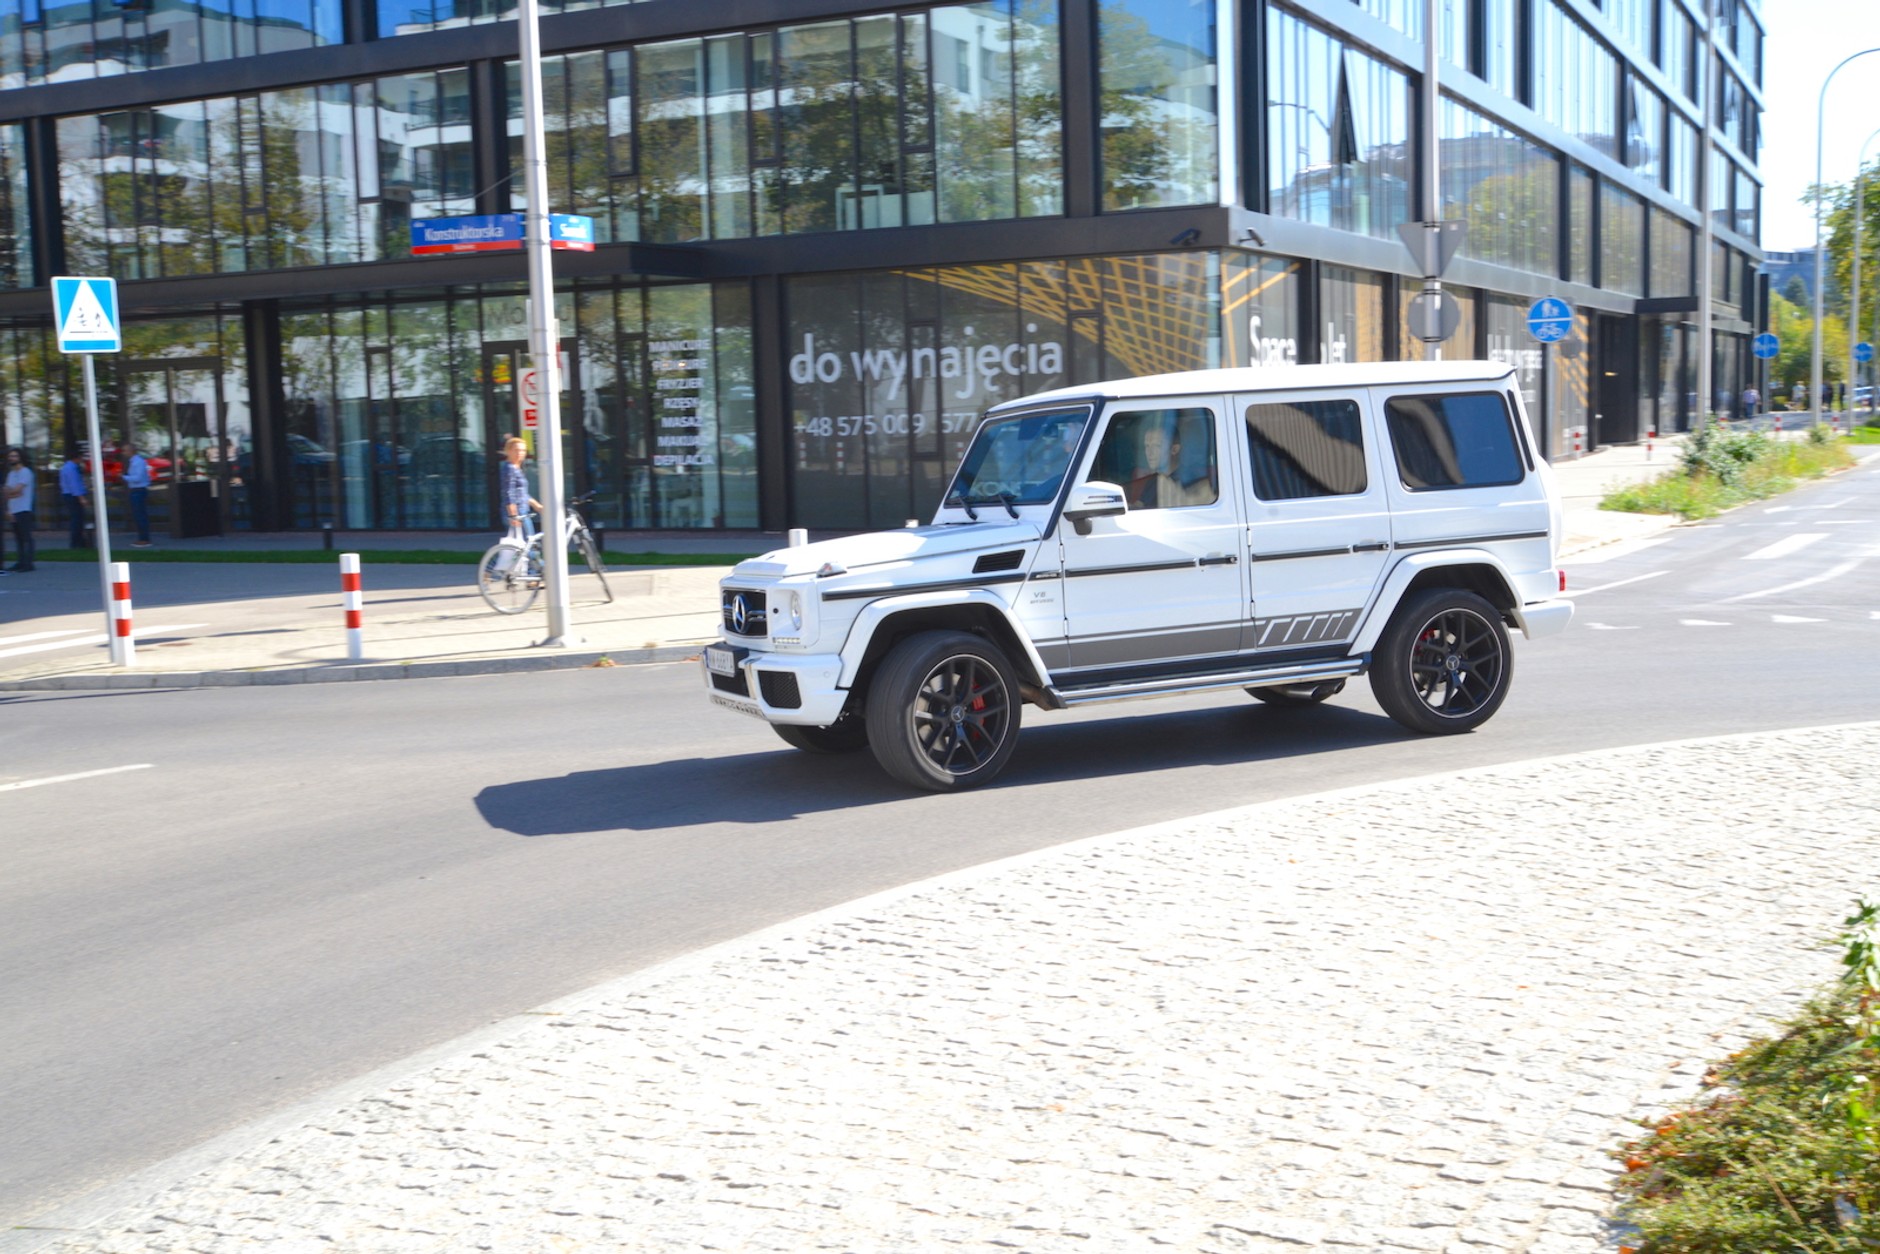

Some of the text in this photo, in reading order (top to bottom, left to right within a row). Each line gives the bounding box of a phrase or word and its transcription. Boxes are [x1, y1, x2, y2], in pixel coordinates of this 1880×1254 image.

[424, 225, 504, 241] Konstruktorska
[648, 339, 711, 352] MANICURE
[789, 322, 1064, 401] do wynajęcia
[794, 417, 833, 437] +48
[837, 415, 878, 436] 575
[942, 412, 979, 434] 577
[653, 454, 715, 466] DEPILACJA
